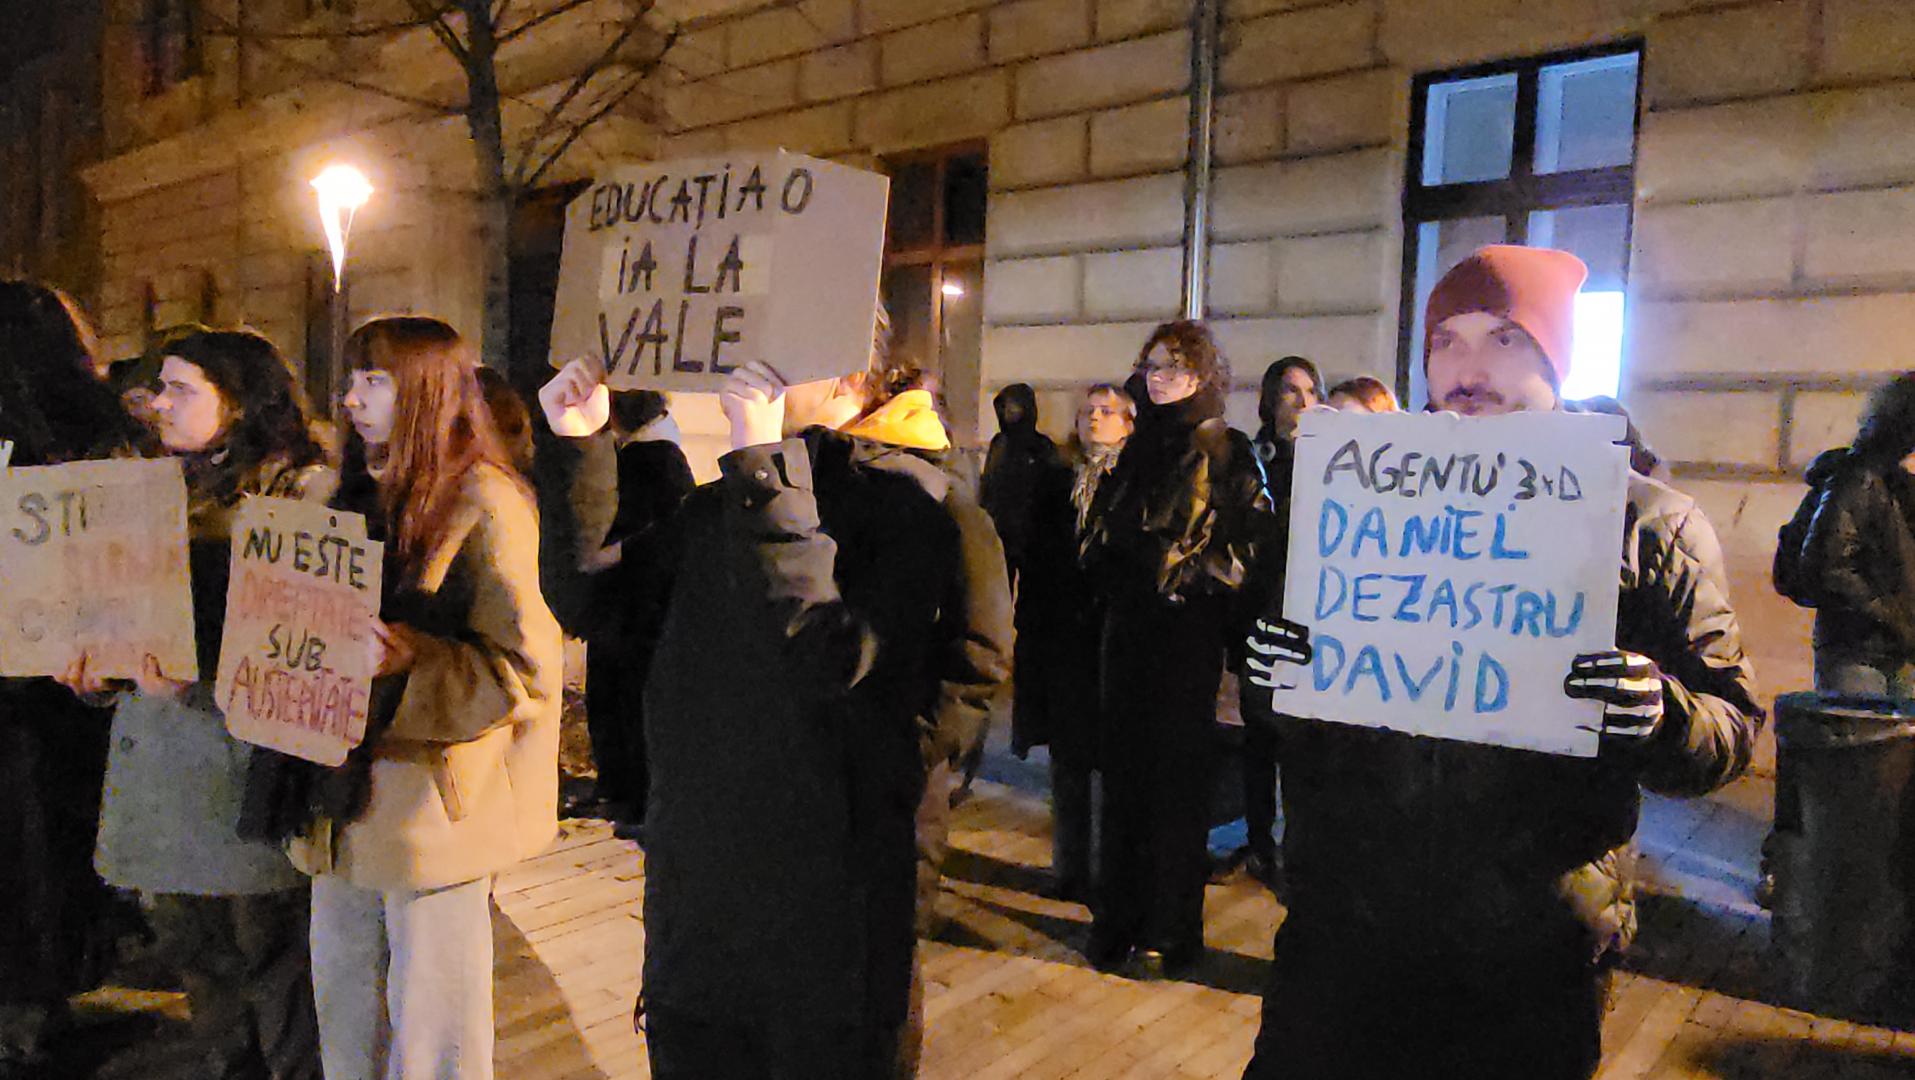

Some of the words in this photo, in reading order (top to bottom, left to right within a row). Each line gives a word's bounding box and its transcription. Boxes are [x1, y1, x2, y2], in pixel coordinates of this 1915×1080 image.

[781, 167, 813, 215] O
[617, 236, 657, 294] IA
[684, 234, 744, 294] LA
[598, 298, 745, 376] VALE
[243, 526, 283, 564] NU
[293, 531, 368, 590] ESTE
[1317, 497, 1530, 560] DANIEL
[1314, 565, 1585, 638] DEZASTRU
[266, 623, 327, 671] SUB
[1312, 634, 1511, 713] DAVID
